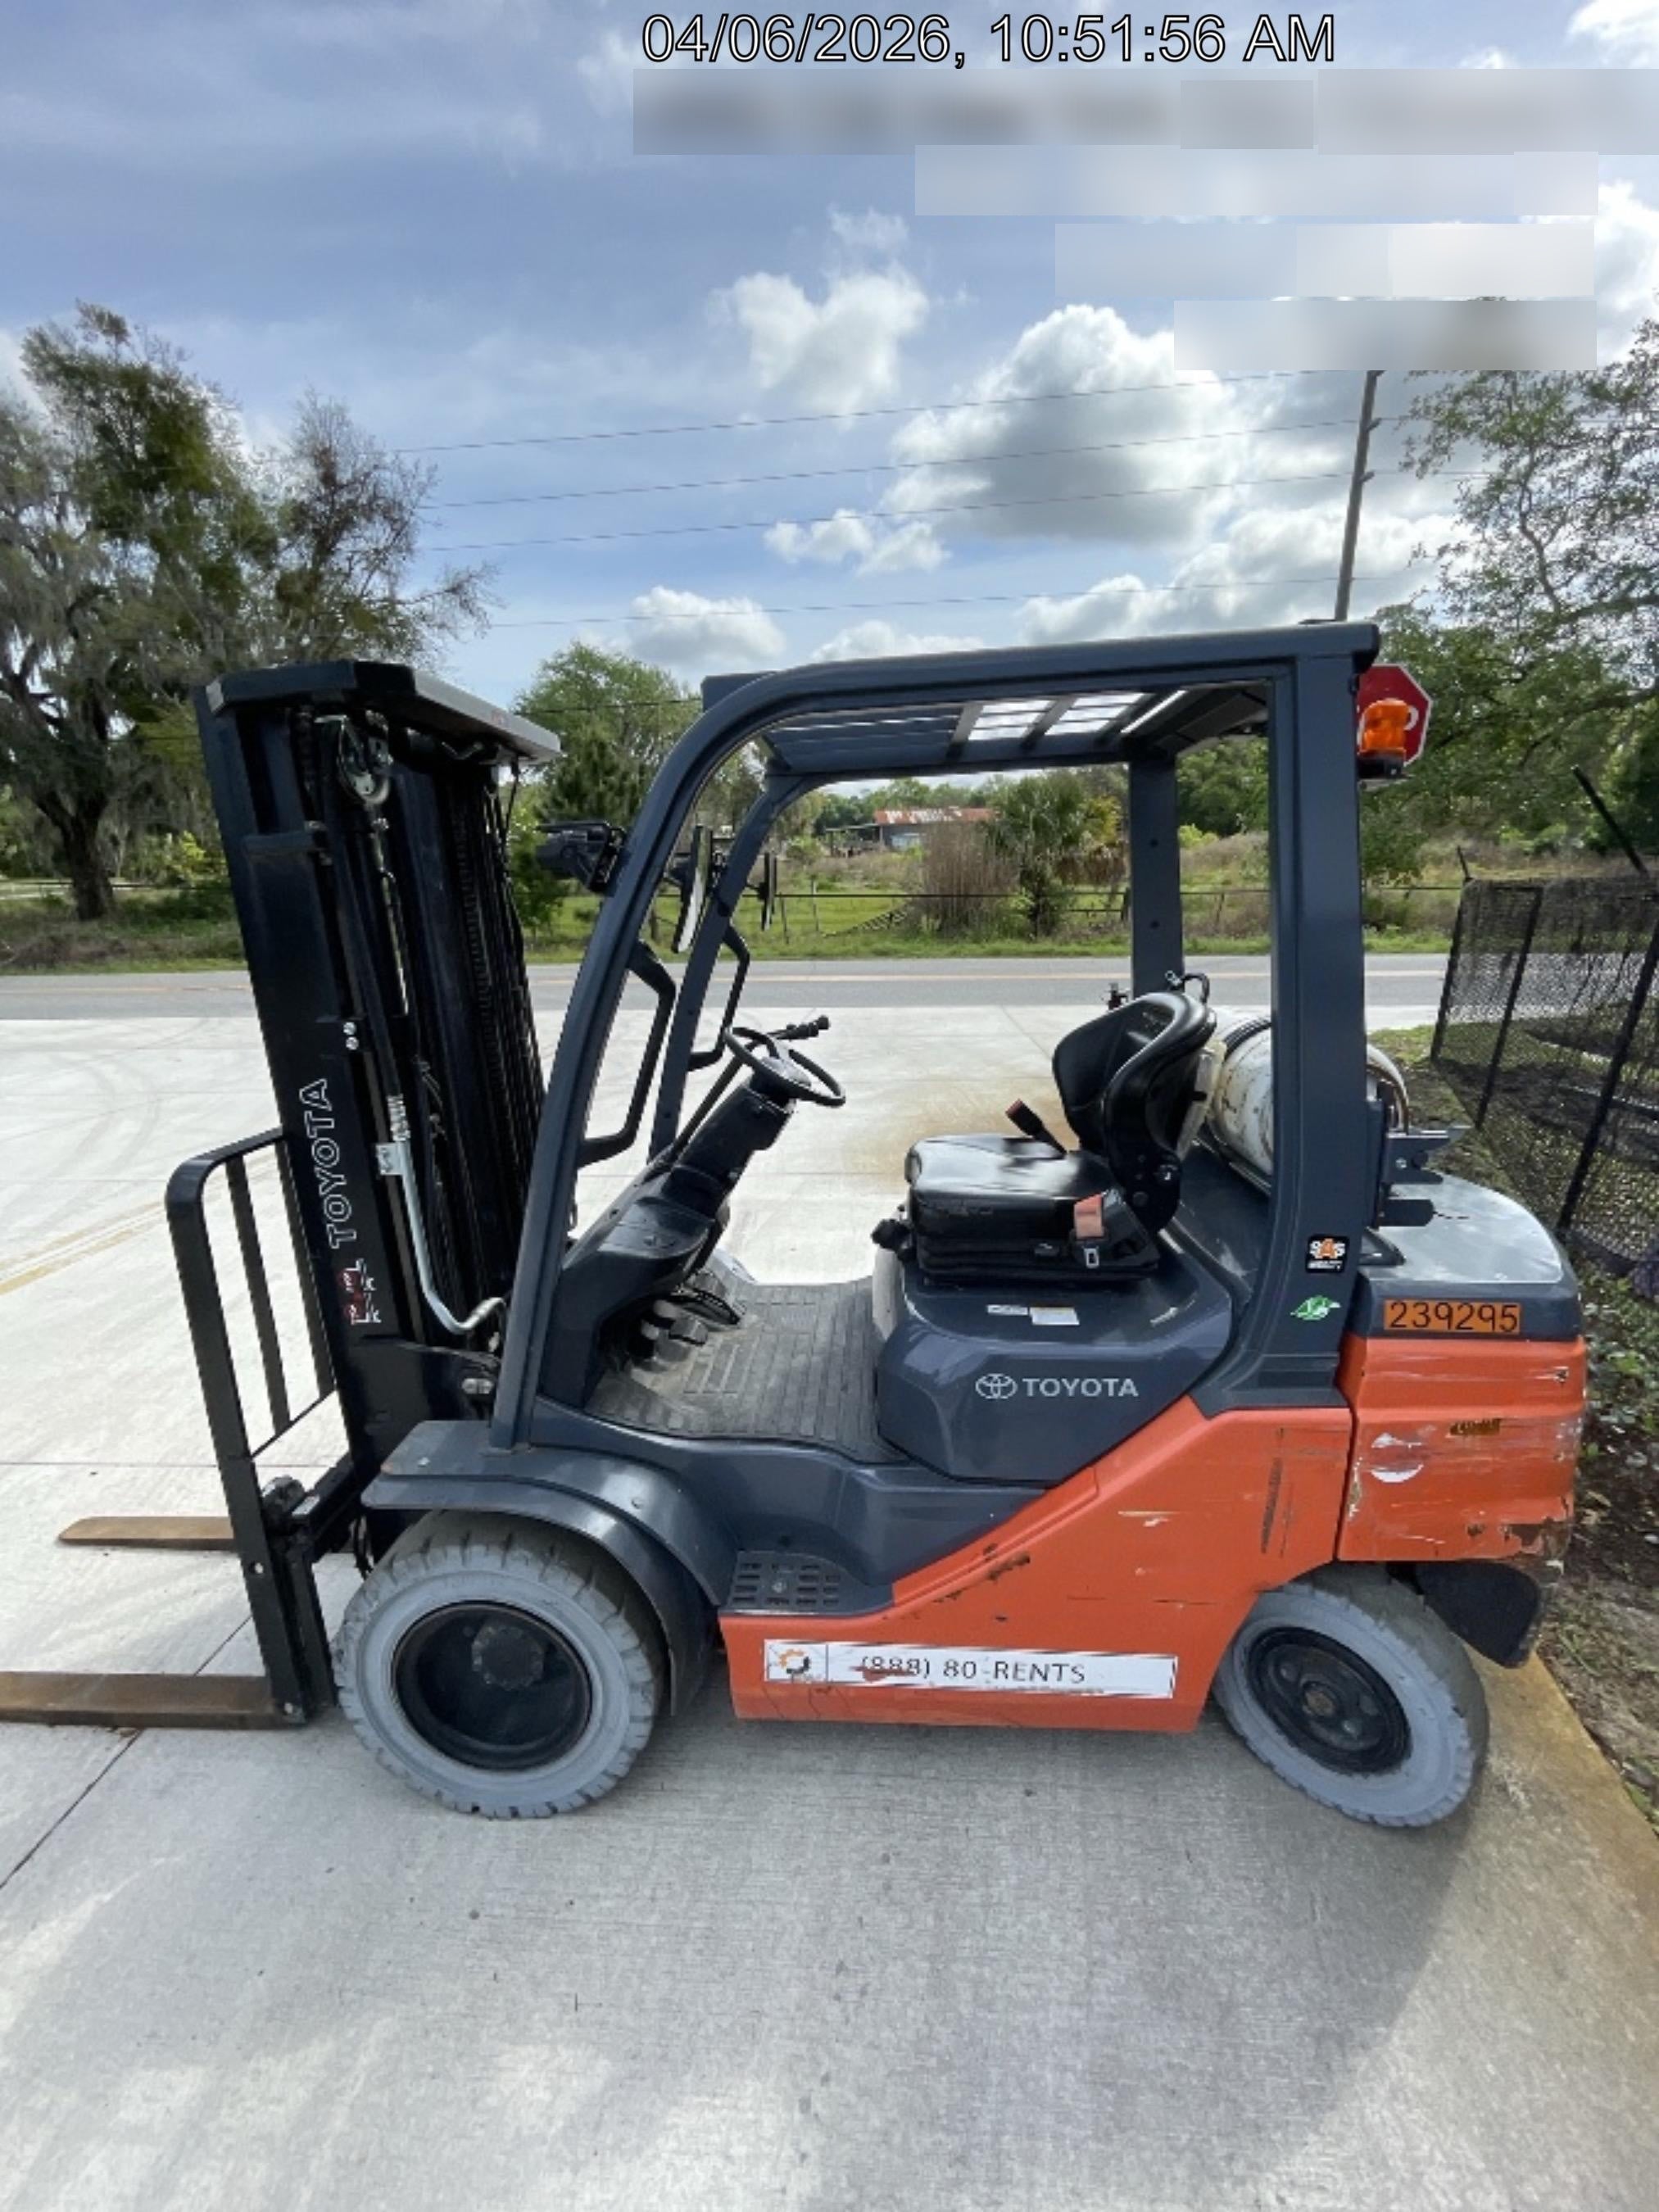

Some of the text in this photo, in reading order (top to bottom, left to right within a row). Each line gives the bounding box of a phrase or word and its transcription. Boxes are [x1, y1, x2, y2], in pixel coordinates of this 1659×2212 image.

[299, 1077, 357, 1250] TOYOTA
[1389, 1301, 1518, 1332] 239295
[1022, 1378, 1139, 1398] TOYOTA
